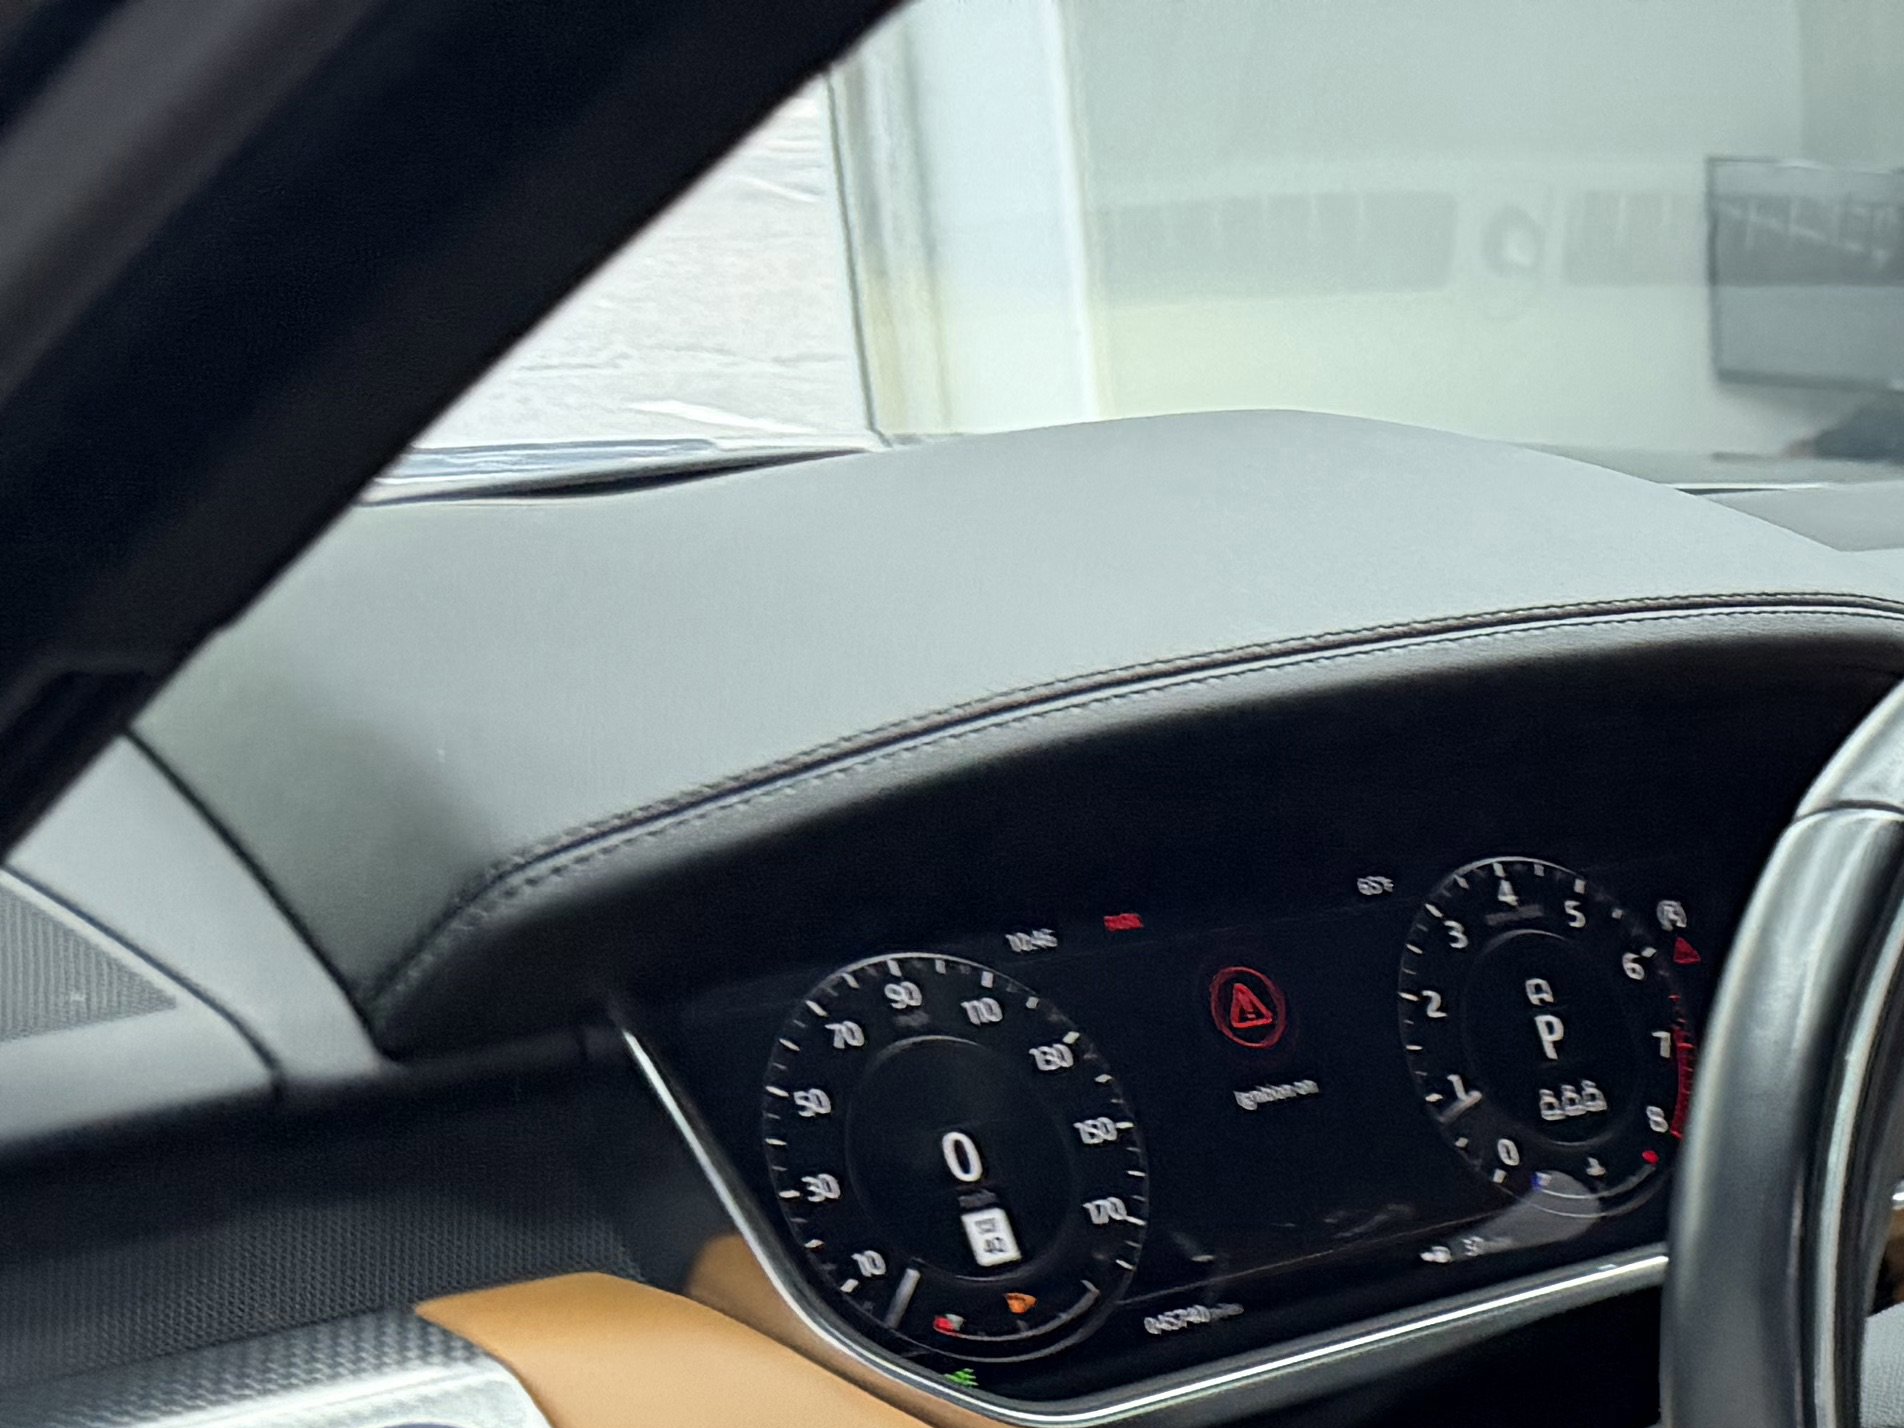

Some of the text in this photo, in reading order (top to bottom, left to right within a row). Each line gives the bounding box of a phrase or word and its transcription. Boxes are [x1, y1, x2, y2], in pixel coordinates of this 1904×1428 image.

[1497, 879, 1519, 907] 4
[1565, 901, 1586, 928] 5
[1443, 920, 1469, 949] 3
[1622, 951, 1645, 981] 6
[884, 981, 923, 1010] 90
[1421, 990, 1448, 1018] 2
[824, 1021, 865, 1049] 70
[1534, 1014, 1565, 1060] P
[1651, 1030, 1672, 1059] 7
[1645, 1105, 1669, 1134] 8
[942, 1131, 983, 1183] 0
[1497, 1138, 1521, 1167] 0
[801, 1173, 841, 1203] 30
[851, 1250, 887, 1278] 10
